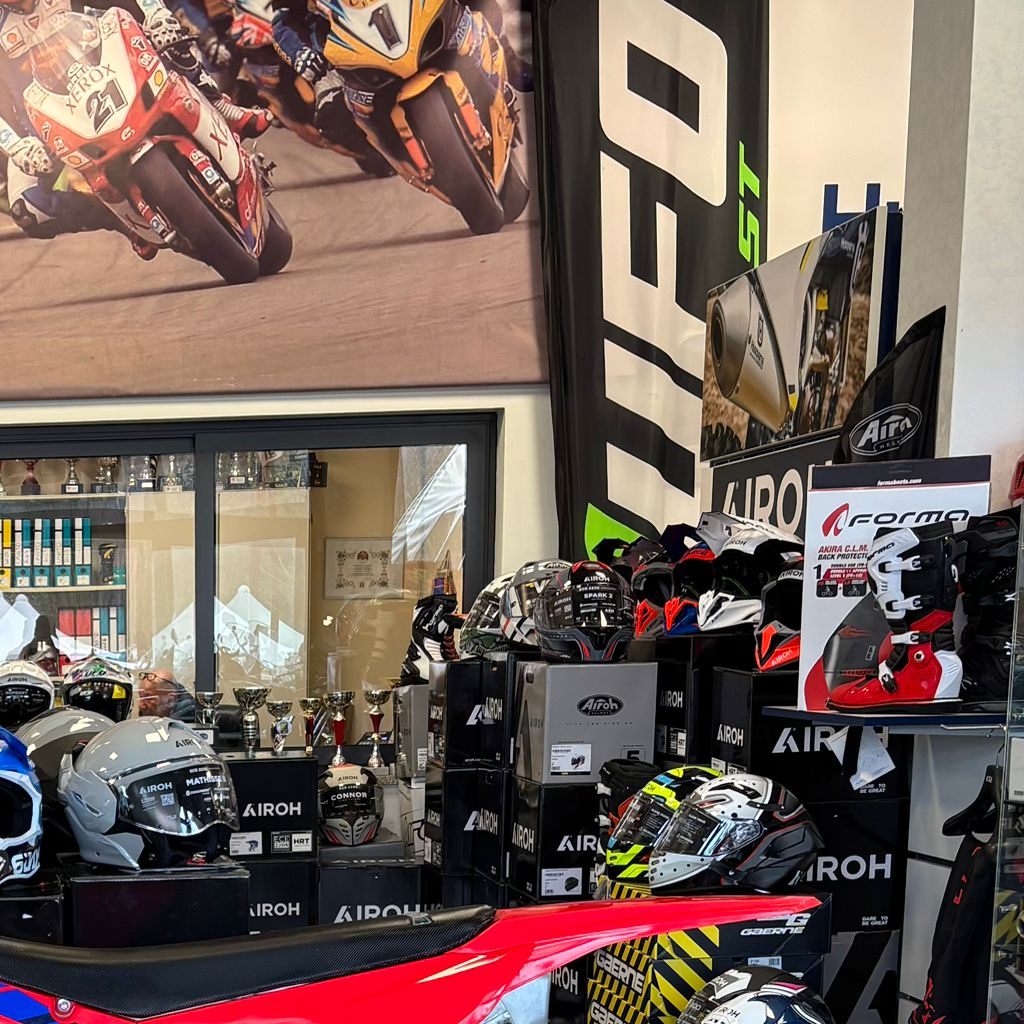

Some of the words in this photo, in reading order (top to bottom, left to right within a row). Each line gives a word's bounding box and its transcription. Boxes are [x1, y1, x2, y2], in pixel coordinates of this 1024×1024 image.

[368, 4, 402, 51] 1
[66, 64, 116, 114] XEROX
[86, 78, 128, 134] 21
[722, 468, 805, 536] AIRO
[818, 545, 843, 553] AKIRA
[844, 544, 869, 552] C.L.M.
[836, 552, 869, 560] PROTECT
[813, 564, 822, 579] 1
[581, 698, 619, 710] Airoh
[717, 724, 744, 747] AIROH
[772, 725, 889, 753] AIRH
[139, 782, 173, 795] AIROH
[331, 792, 367, 801] CONNOR
[242, 802, 301, 817] AIROH
[479, 808, 498, 835] AIROH
[511, 822, 535, 853] AIROH
[557, 834, 597, 851] AIR
[551, 966, 579, 995] IROH
